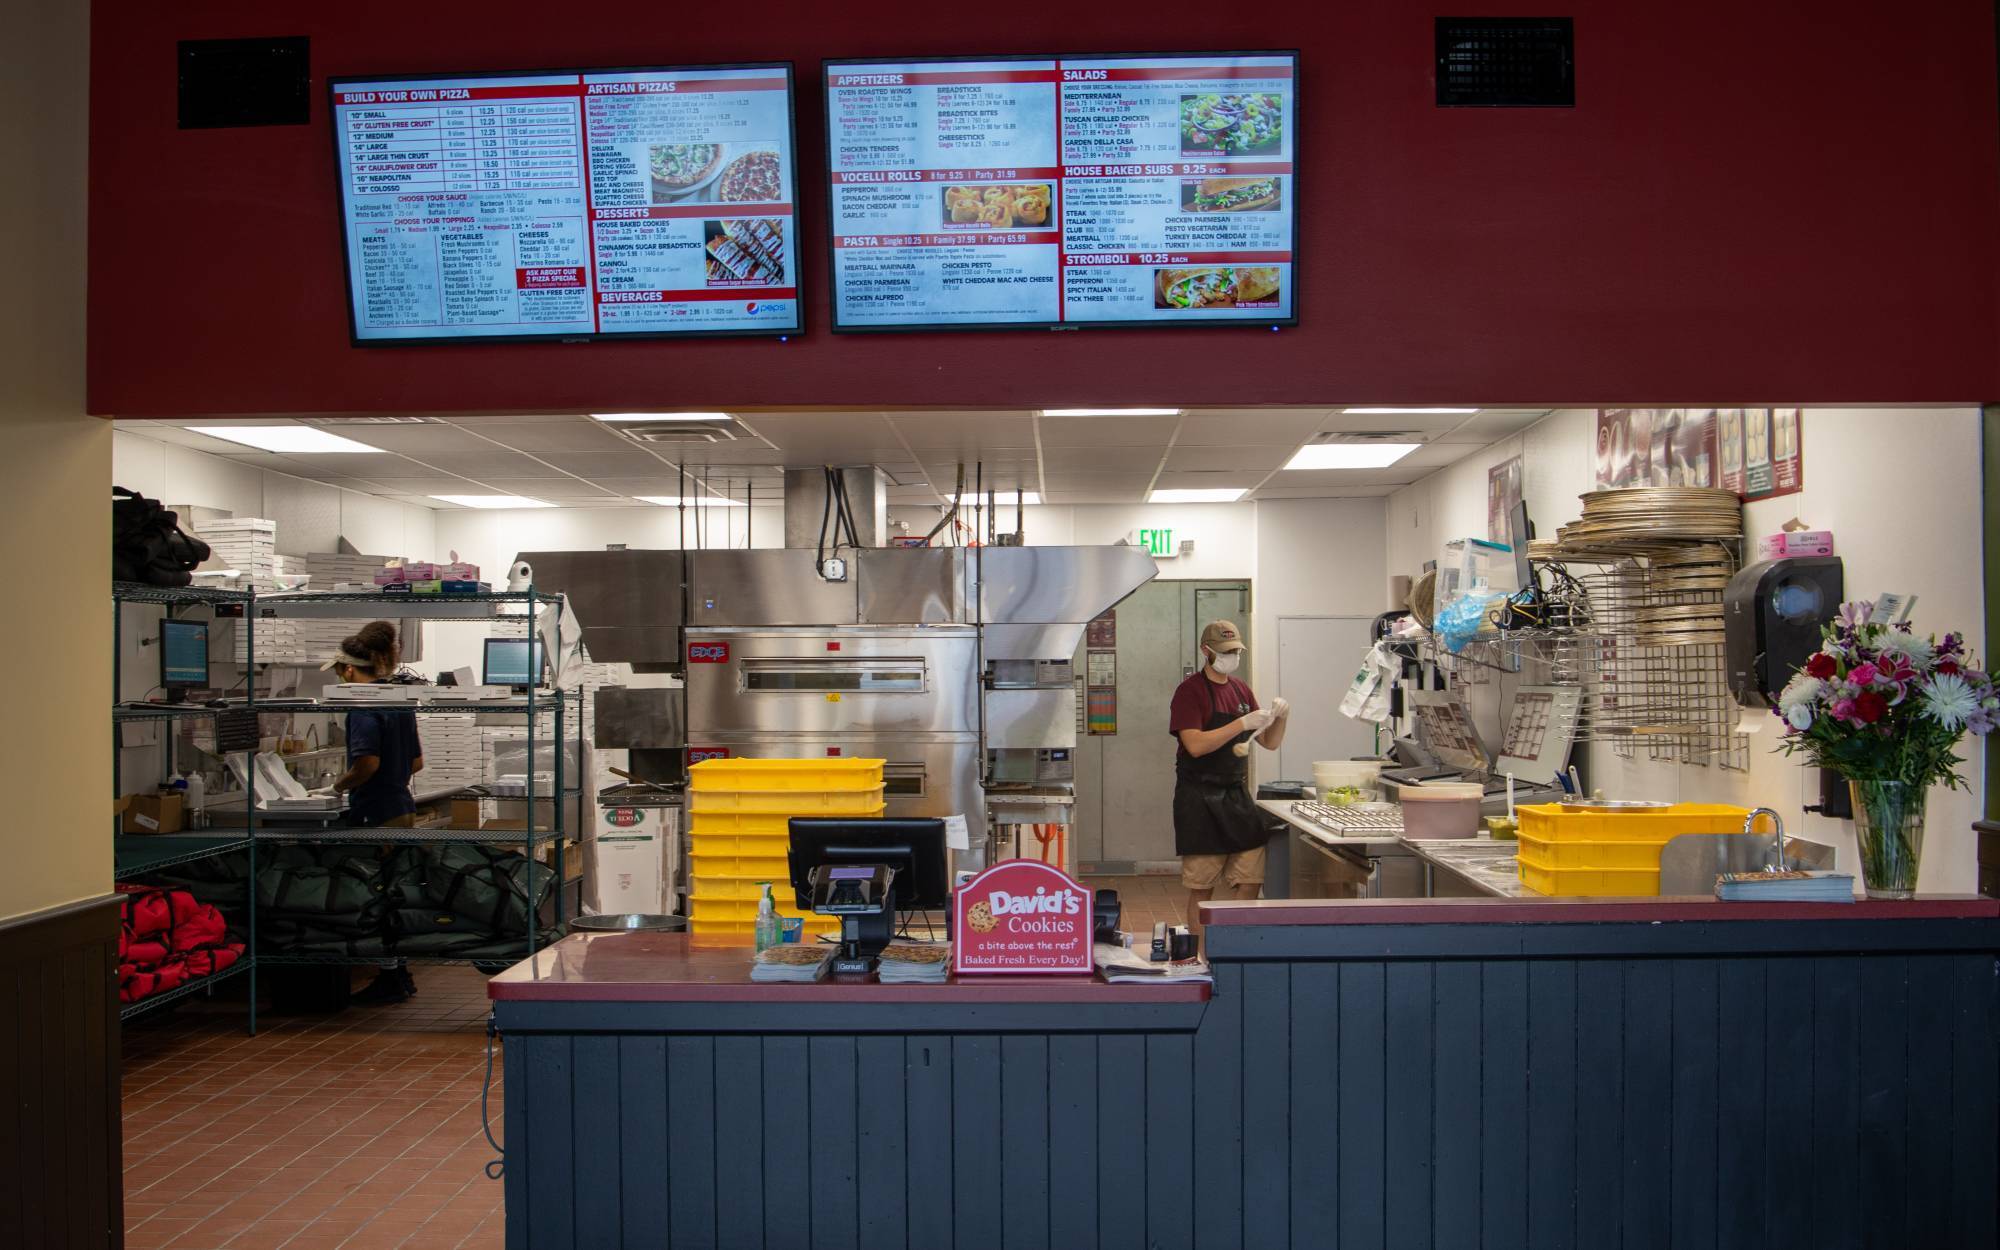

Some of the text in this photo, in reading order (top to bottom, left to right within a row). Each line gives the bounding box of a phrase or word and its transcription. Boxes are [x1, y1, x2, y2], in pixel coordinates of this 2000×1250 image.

[838, 75, 903, 85] APPETIZERS
[1064, 70, 1107, 80] SALADS
[588, 82, 675, 94] ARTISAN PIZZAS
[344, 90, 470, 103] BUILD YOUR OWN PIZZA
[1065, 167, 1102, 176] HOUSE
[1105, 166, 1141, 175] BAKED
[1145, 165, 1173, 174] SUBS
[1183, 165, 1206, 174] 9.25
[841, 173, 884, 182] VOCELLI
[887, 172, 921, 181] ROLLS
[976, 171, 993, 180] Party
[596, 209, 649, 219] DESSERTS
[843, 234, 1026, 246] PASTA Single 10.25 Family 37.99 Party 65.99
[1067, 255, 1129, 264] STROMBOLI
[1139, 254, 1168, 263] 10.25
[601, 292, 662, 302] BEVERAGES
[760, 304, 785, 313] pepsi
[1140, 530, 1172, 554] EXIT
[989, 886, 1080, 915] David's
[1009, 917, 1073, 932] Cookies
[987, 941, 1005, 950] bite
[1008, 942, 1034, 950] above
[1038, 941, 1052, 949] the
[965, 955, 1083, 966] Baked Fresh Every Day!
